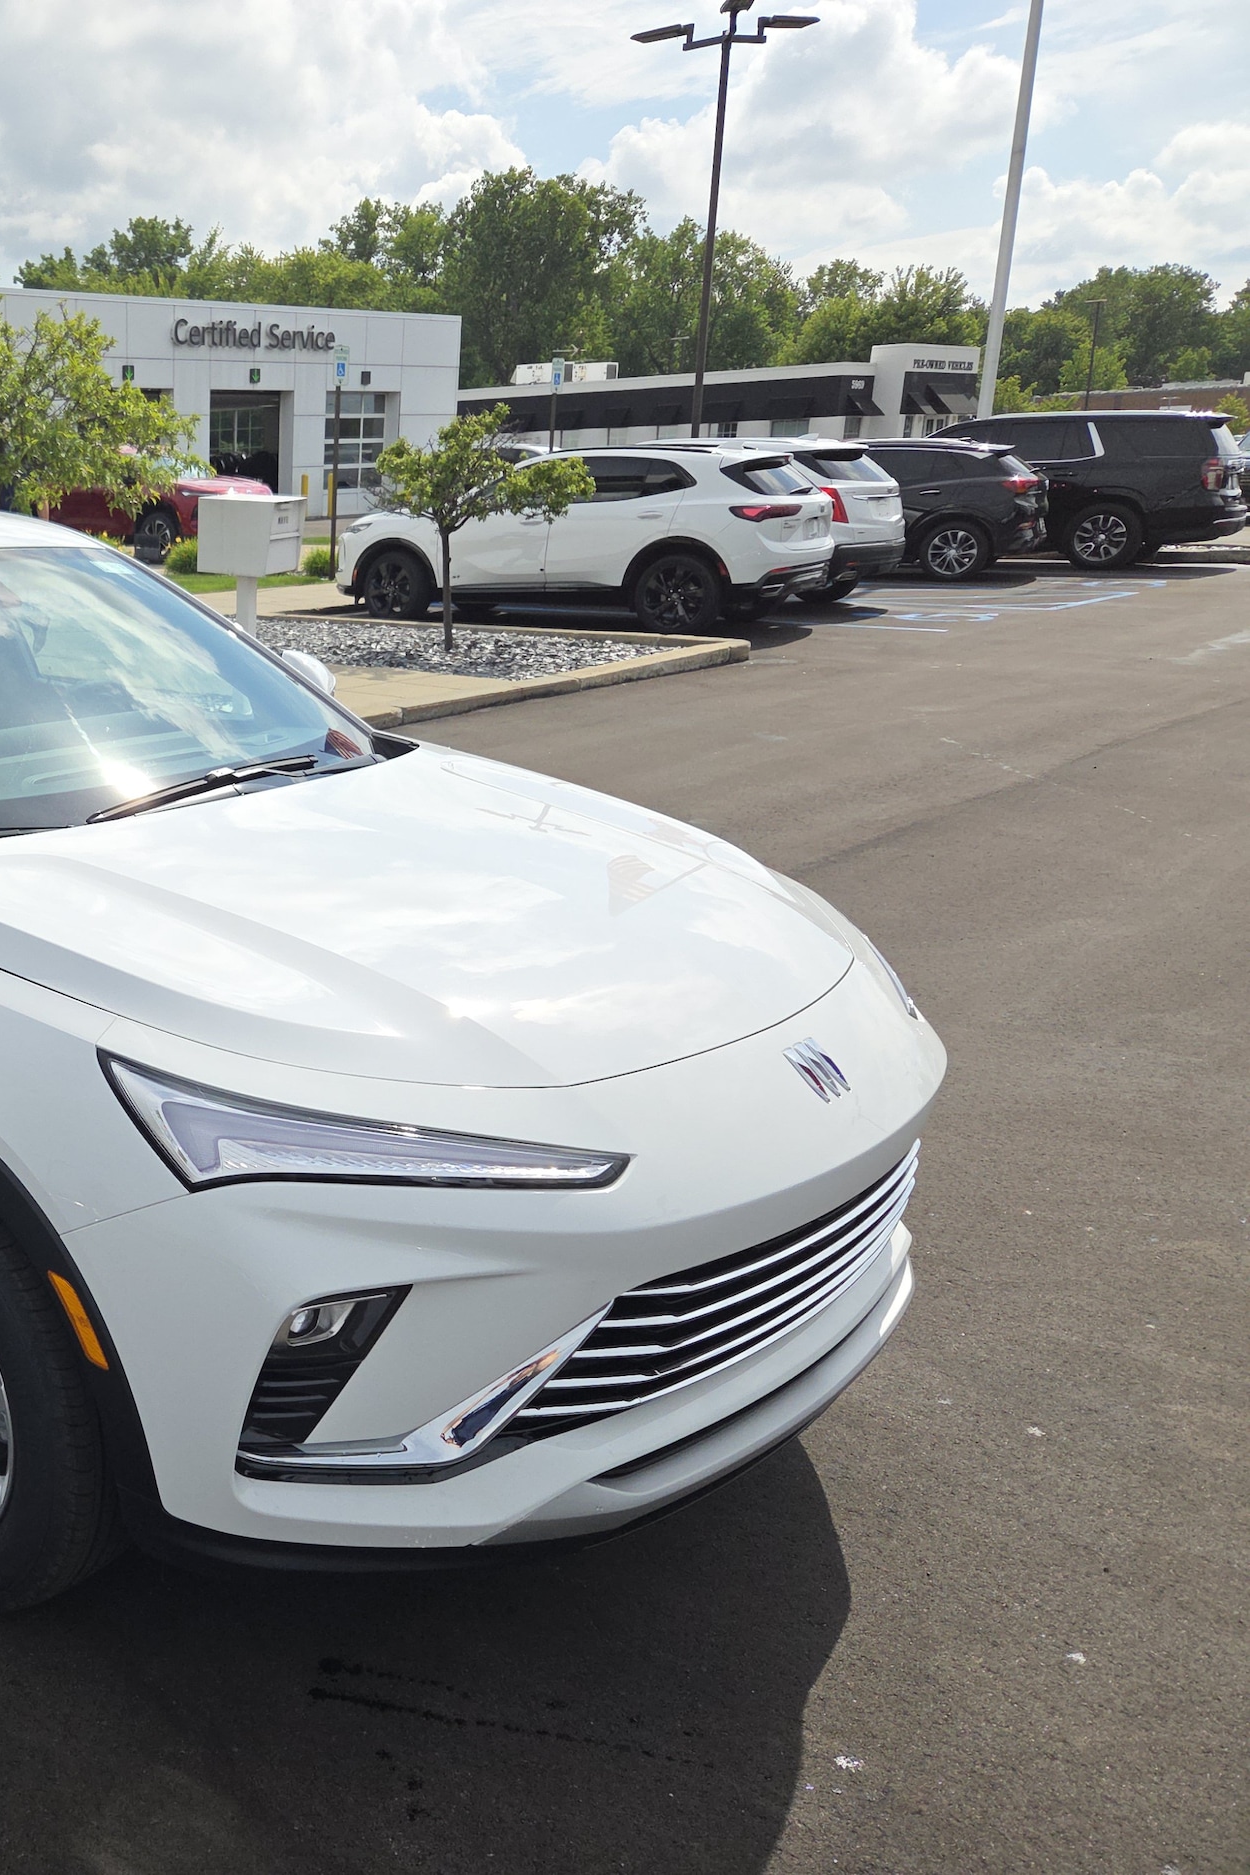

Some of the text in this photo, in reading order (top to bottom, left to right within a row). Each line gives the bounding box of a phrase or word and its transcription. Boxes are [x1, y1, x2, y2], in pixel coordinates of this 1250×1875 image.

[173, 318, 336, 351] Certified Service
[912, 358, 974, 371] PRE-OWNED VEHICLES
